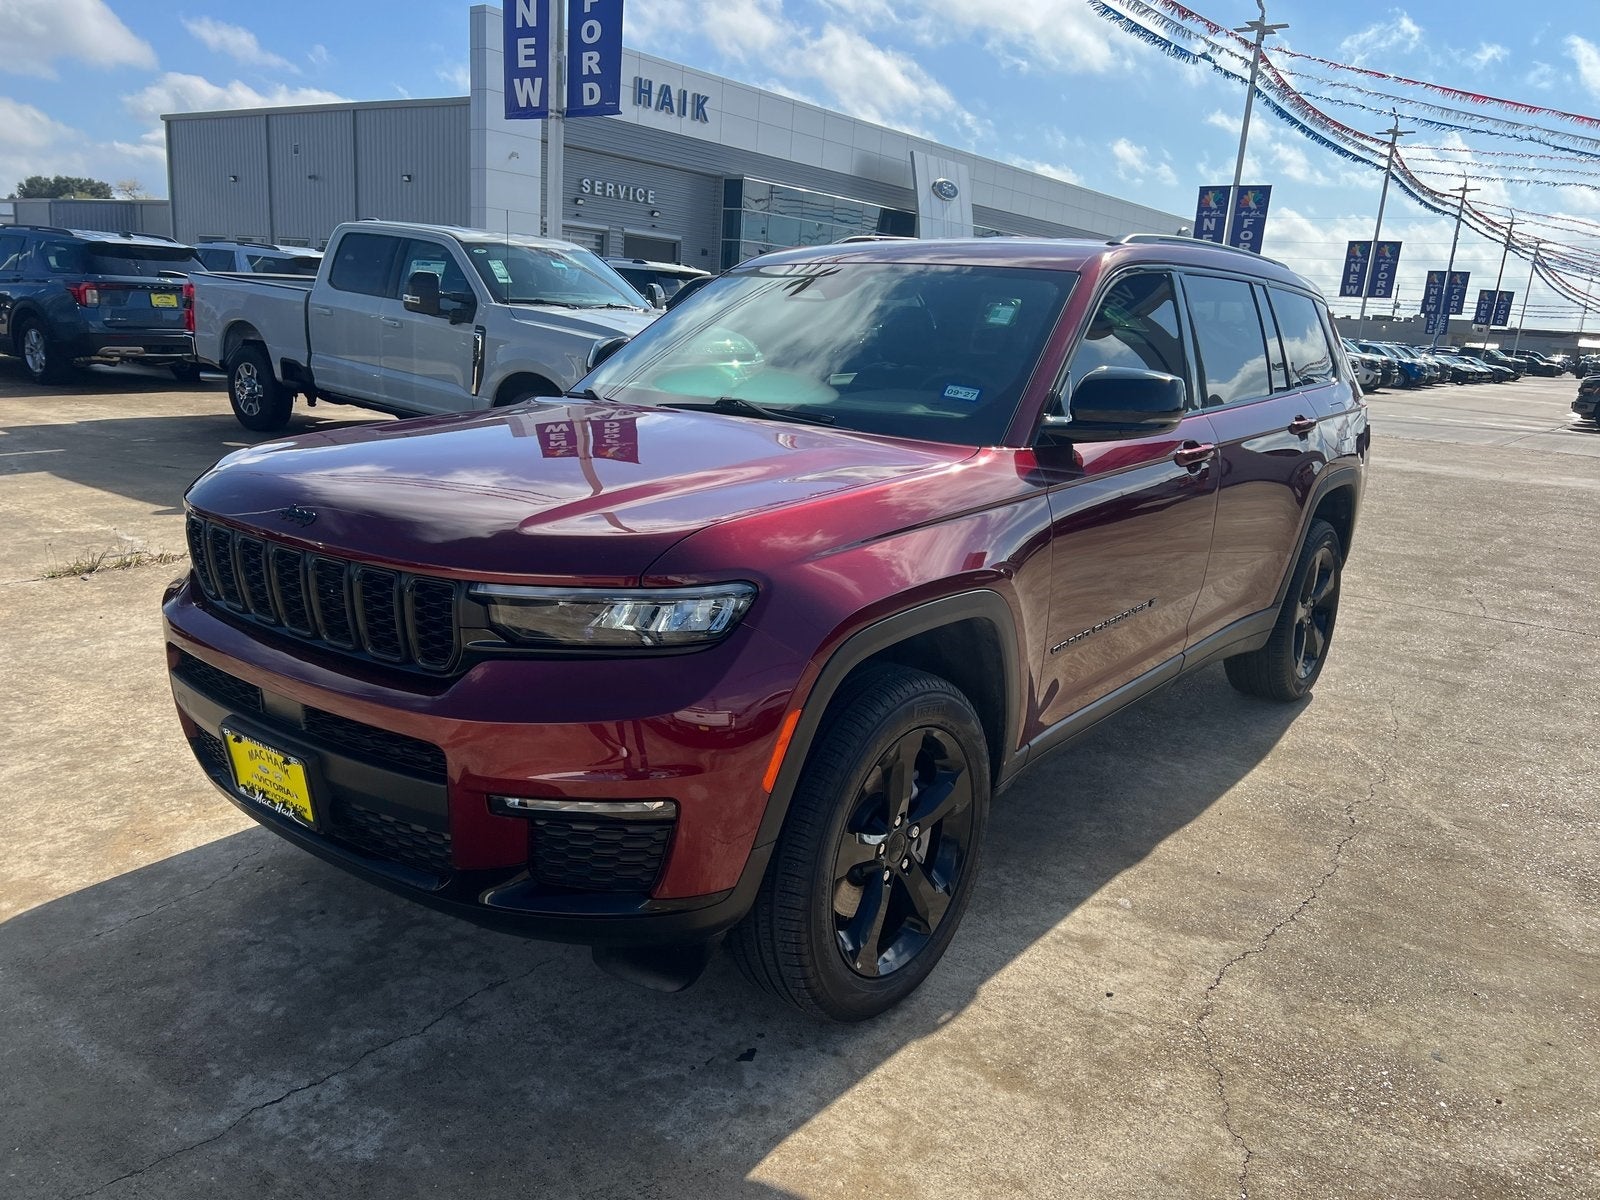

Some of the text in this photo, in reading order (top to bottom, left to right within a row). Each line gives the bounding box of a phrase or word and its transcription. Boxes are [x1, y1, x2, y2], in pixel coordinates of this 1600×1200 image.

[513, 0, 543, 108] NEW
[633, 75, 710, 124] HAIK
[581, 178, 656, 204] SERVICE
[1202, 218, 1216, 241] NE
[1239, 218, 1254, 251] FOR
[1345, 263, 1360, 295] NEW
[1375, 263, 1390, 296] FORD
[1426, 287, 1438, 312] NEW
[1449, 288, 1461, 313] FORD
[1476, 303, 1488, 323] NEW
[1496, 304, 1507, 325] FORD
[946, 388, 977, 399] 09-27
[247, 749, 266, 761] MAC
[254, 791, 273, 807] Mac
